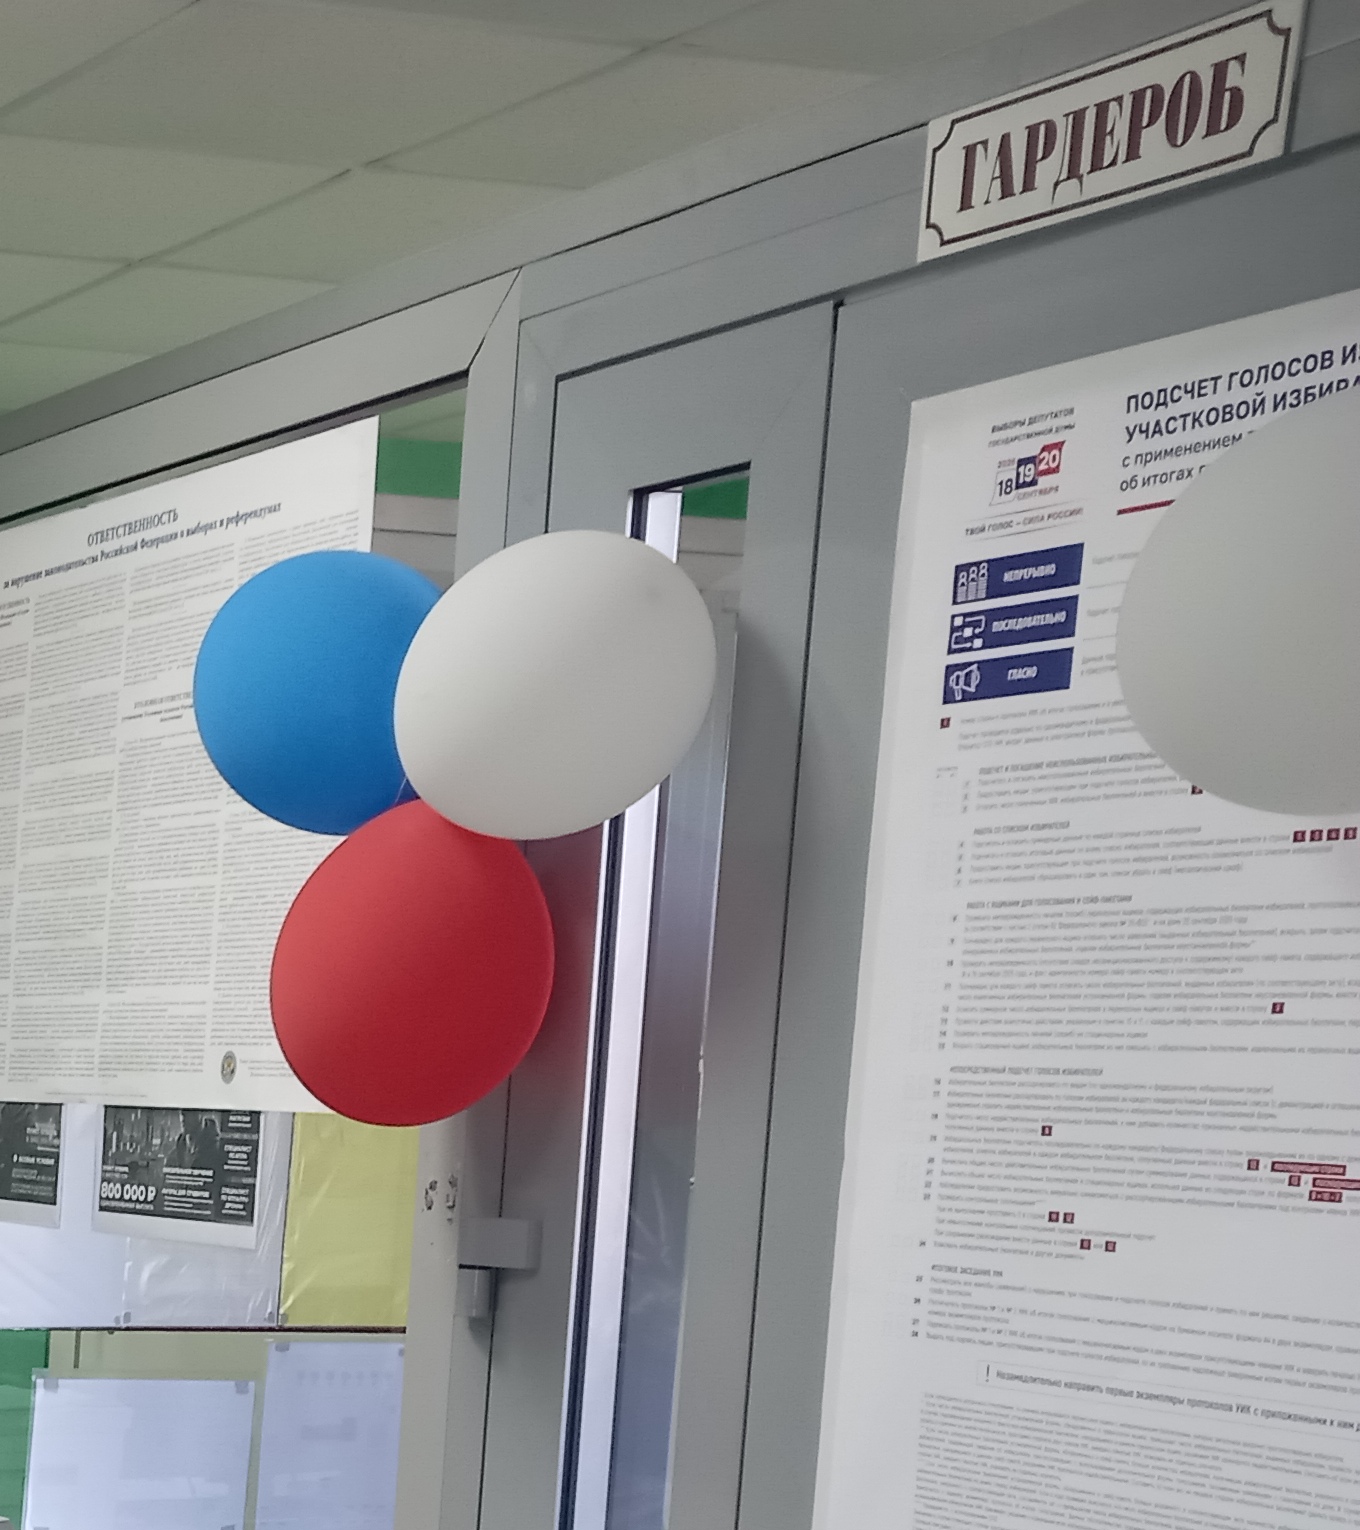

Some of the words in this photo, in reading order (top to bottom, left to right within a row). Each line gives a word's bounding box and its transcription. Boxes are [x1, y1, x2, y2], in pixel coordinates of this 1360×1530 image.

[957, 52, 1247, 204] ГАРДЕРОБ
[1126, 375, 1223, 414] ПОДСЧЕТ
[1227, 349, 1334, 392] ГОЛОСОВ
[991, 419, 1026, 434] ВЫБОРЫ
[1027, 407, 1075, 426] ДЕПУТАТОВ
[1125, 392, 1266, 444] УЧАСТКОВОЙ
[1038, 450, 1060, 471] 20
[1122, 455, 1130, 468] с
[1134, 431, 1243, 468] применением
[1018, 463, 1035, 484] 19
[1119, 475, 1138, 492] об
[1141, 466, 1194, 488] итогах
[998, 478, 1013, 497] 18
[87, 508, 179, 547] ОТВЕТСТВЕННОСТЬ
[99, 540, 139, 563] Российской
[139, 532, 179, 552] Федерации
[186, 520, 218, 538] выборах
[224, 502, 282, 530] референдумах
[965, 523, 986, 536] ТВОЙ
[988, 520, 1013, 531] ГОЛОС
[1003, 563, 1056, 583] НЕПРЕРЫВНО
[1007, 665, 1038, 681] ГЛАСНО
[101, 1181, 122, 1199] 800
[123, 1185, 146, 1202] 000
[1235, 1403, 1252, 1414] УИК
